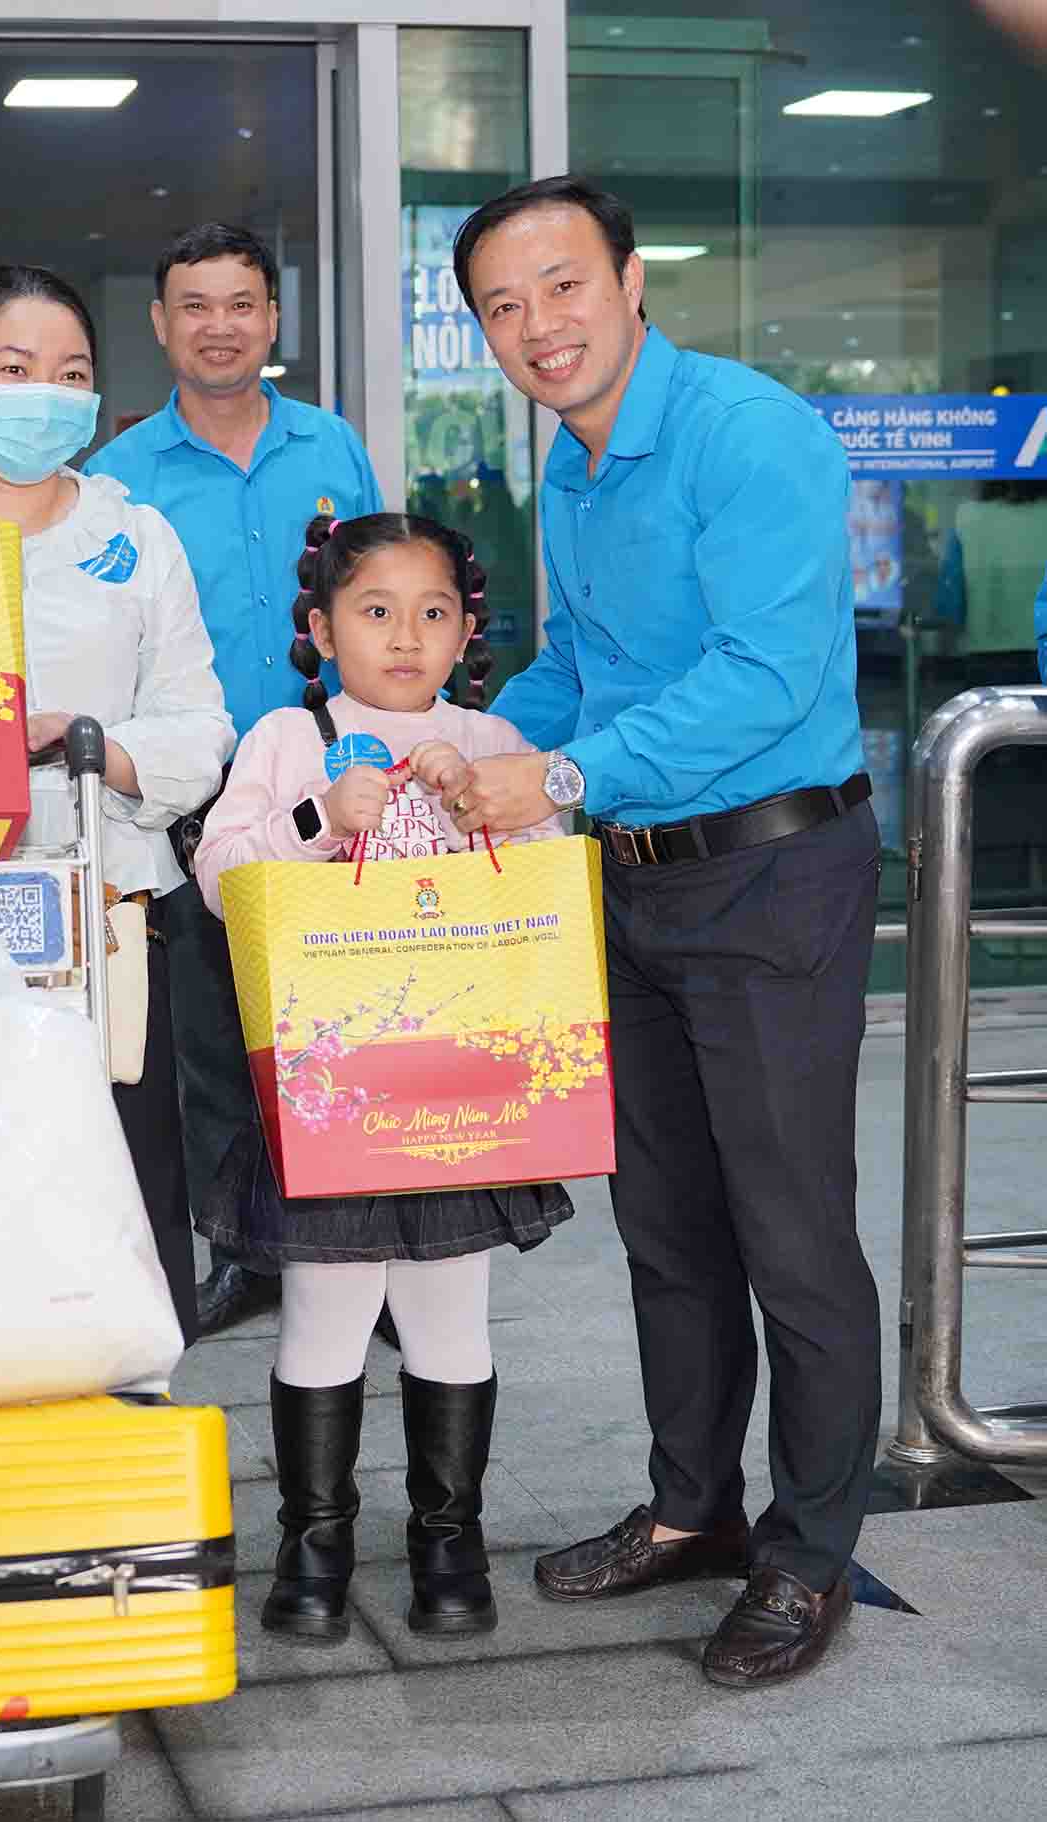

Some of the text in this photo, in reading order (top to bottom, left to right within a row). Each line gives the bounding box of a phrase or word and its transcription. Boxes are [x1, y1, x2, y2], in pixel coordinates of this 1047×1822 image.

[936, 405, 996, 427] KHÔNG
[421, 926, 447, 938] LAO
[526, 914, 559, 929] NAM
[303, 949, 346, 959] VIETNAM
[348, 946, 393, 957] GENERAL
[396, 942, 474, 953] CONFEDERATION
[492, 935, 529, 948] LABOUR
[402, 1129, 499, 1146] HAPPY NEW YEAR
